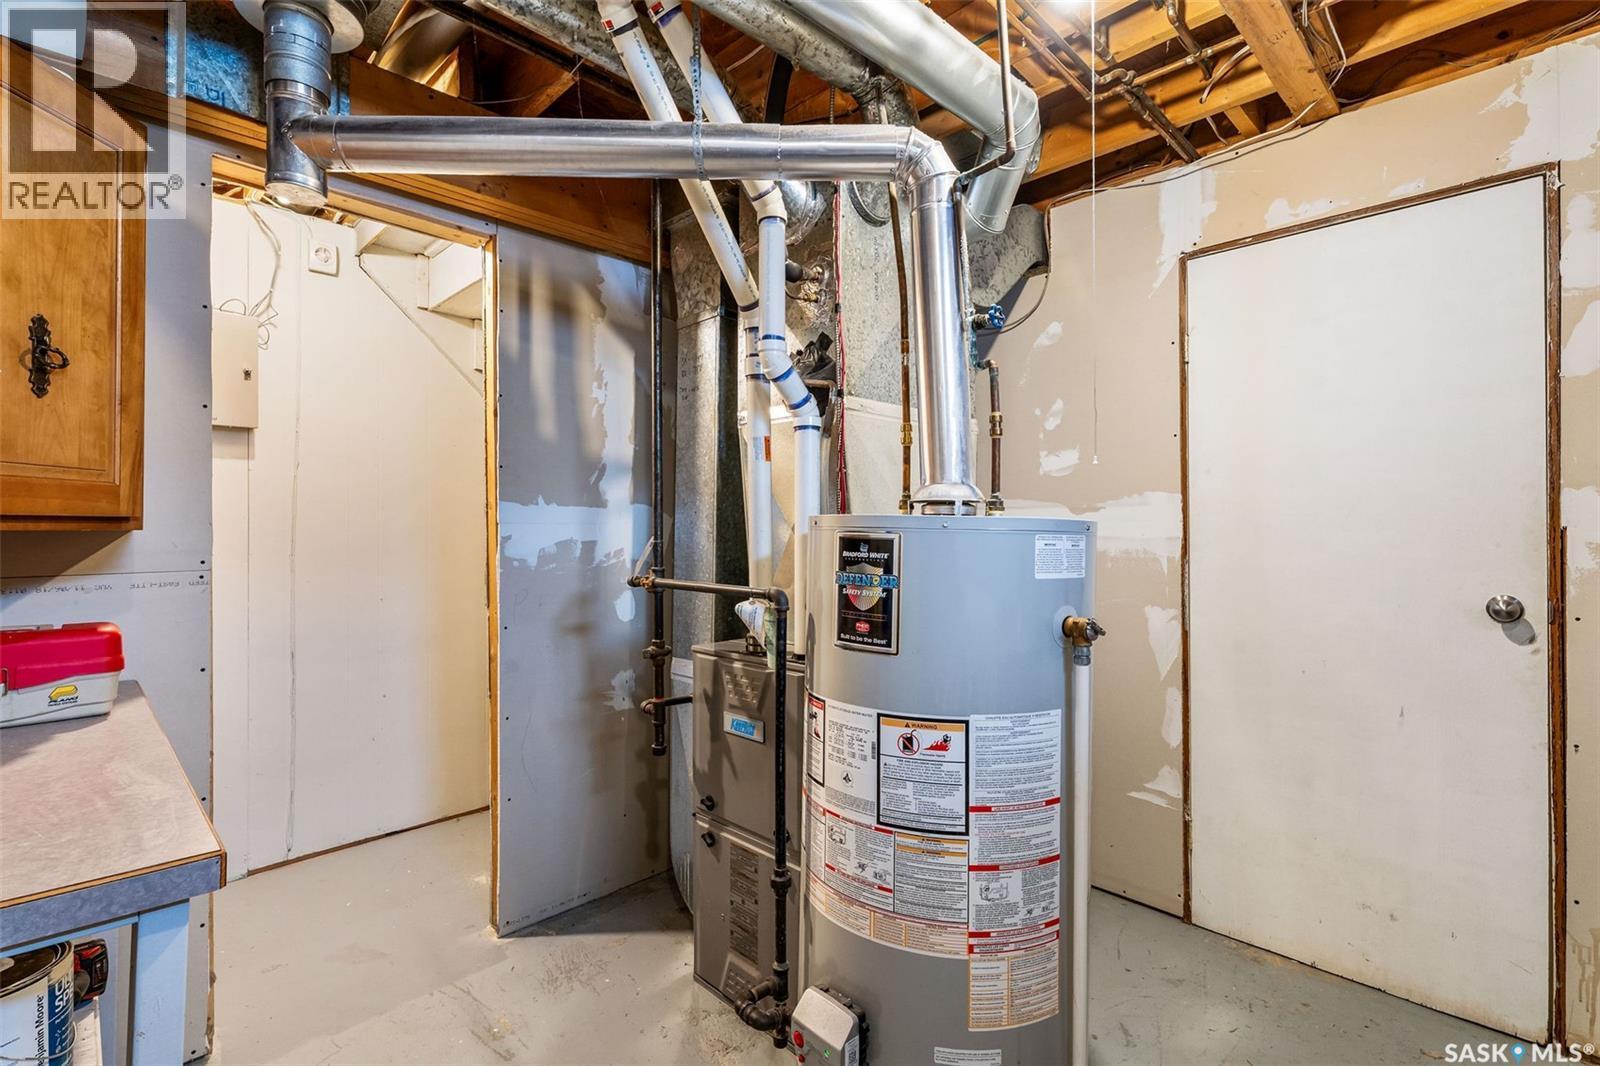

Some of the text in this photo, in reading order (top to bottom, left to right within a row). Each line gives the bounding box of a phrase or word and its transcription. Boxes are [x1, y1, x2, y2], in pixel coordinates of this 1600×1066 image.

[842, 550, 869, 558] BRADFORD
[837, 571, 899, 589] DEFENDER
[842, 587, 861, 596] SAFETY
[911, 722, 938, 730] WARNING
